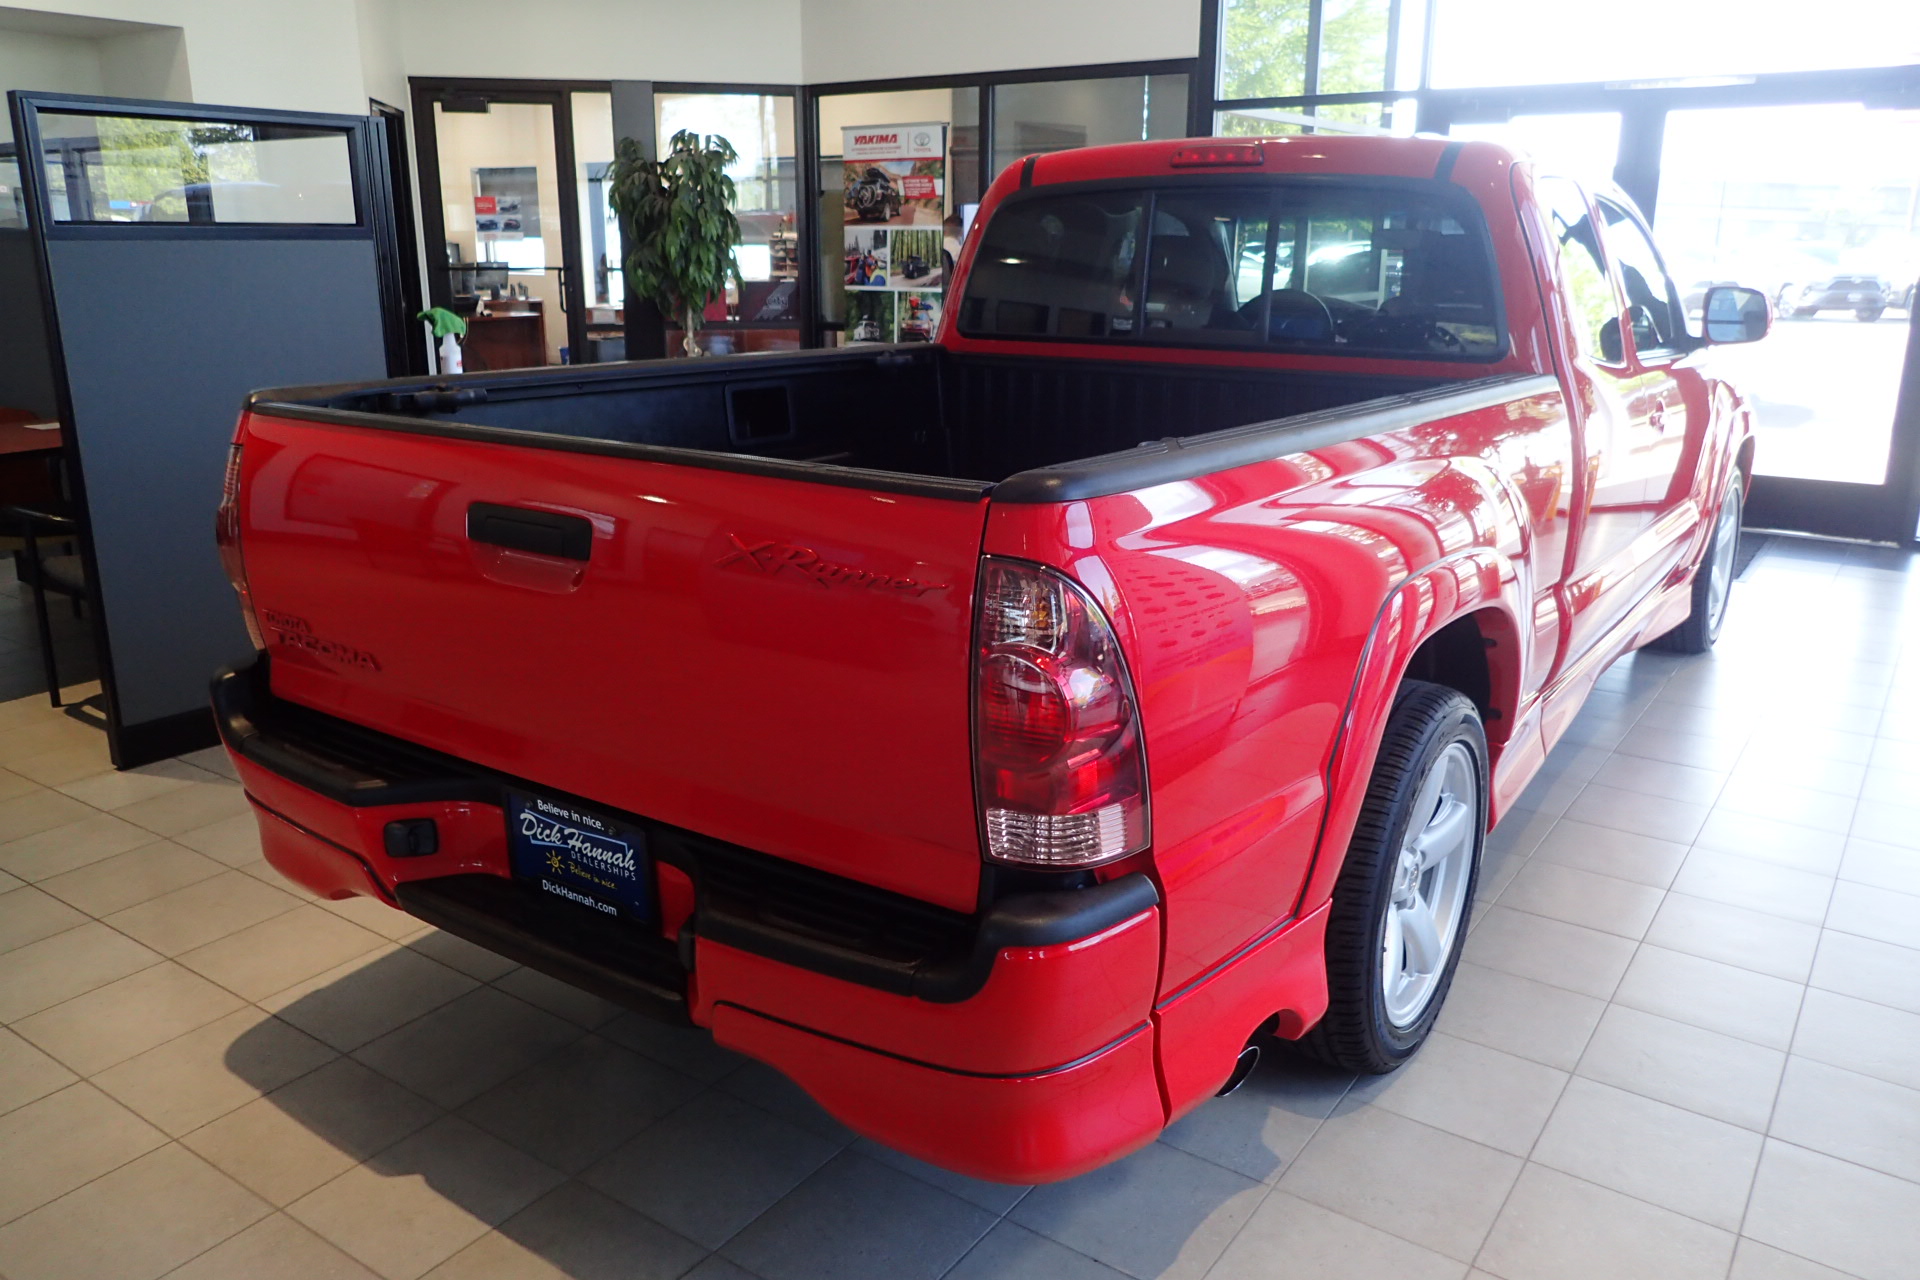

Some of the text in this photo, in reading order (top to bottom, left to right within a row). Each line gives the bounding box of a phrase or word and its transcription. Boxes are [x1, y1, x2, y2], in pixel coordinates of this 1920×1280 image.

[853, 133, 898, 145] YAKIMA
[270, 626, 382, 673] TACOMA
[537, 799, 605, 831] Believe in nice.
[520, 812, 637, 871] Dick Hannah
[570, 850, 636, 881] DEALERSHIPS
[542, 879, 618, 917] DickHannah.com
